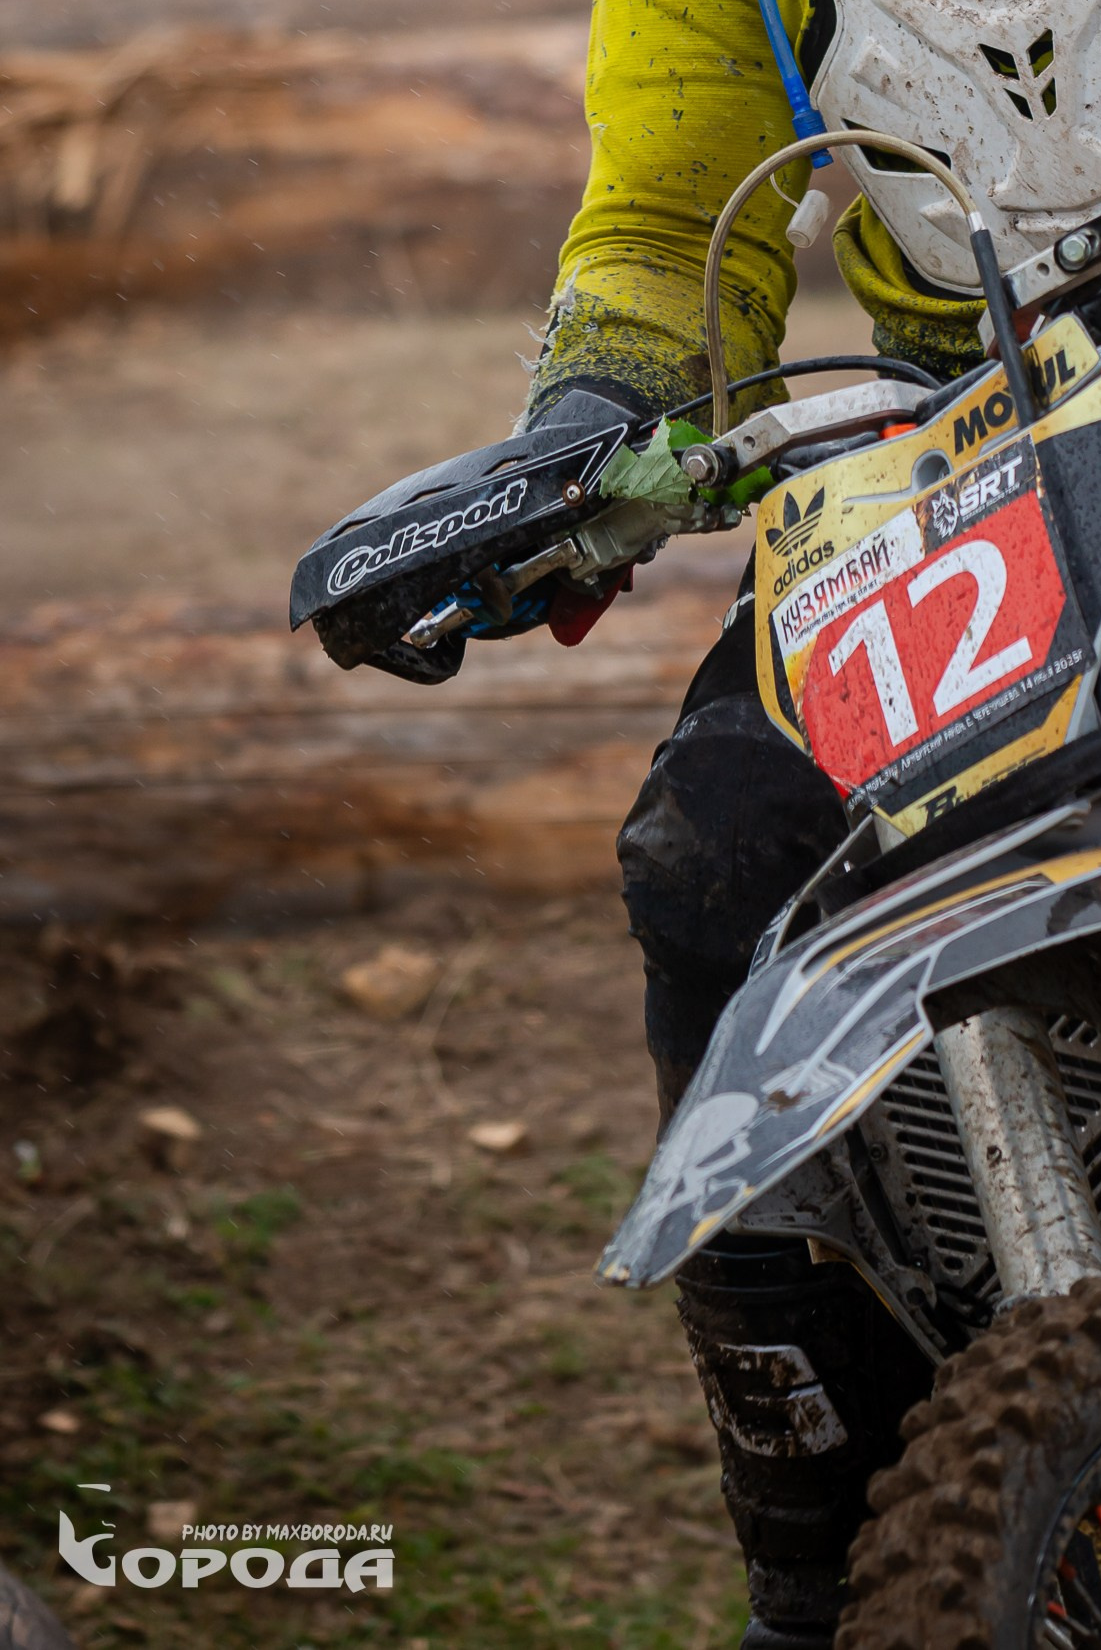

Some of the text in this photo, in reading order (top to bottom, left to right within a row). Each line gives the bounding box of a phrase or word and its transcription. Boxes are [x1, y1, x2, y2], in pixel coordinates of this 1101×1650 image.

[953, 349, 1075, 456] MOUL
[327, 478, 526, 596] Polisport
[959, 456, 1022, 517] SRT
[774, 540, 834, 596] adidas
[781, 534, 890, 644] КУЗЯМБАЙ
[828, 540, 1033, 746] 12
[1019, 677, 1033, 693] 14
